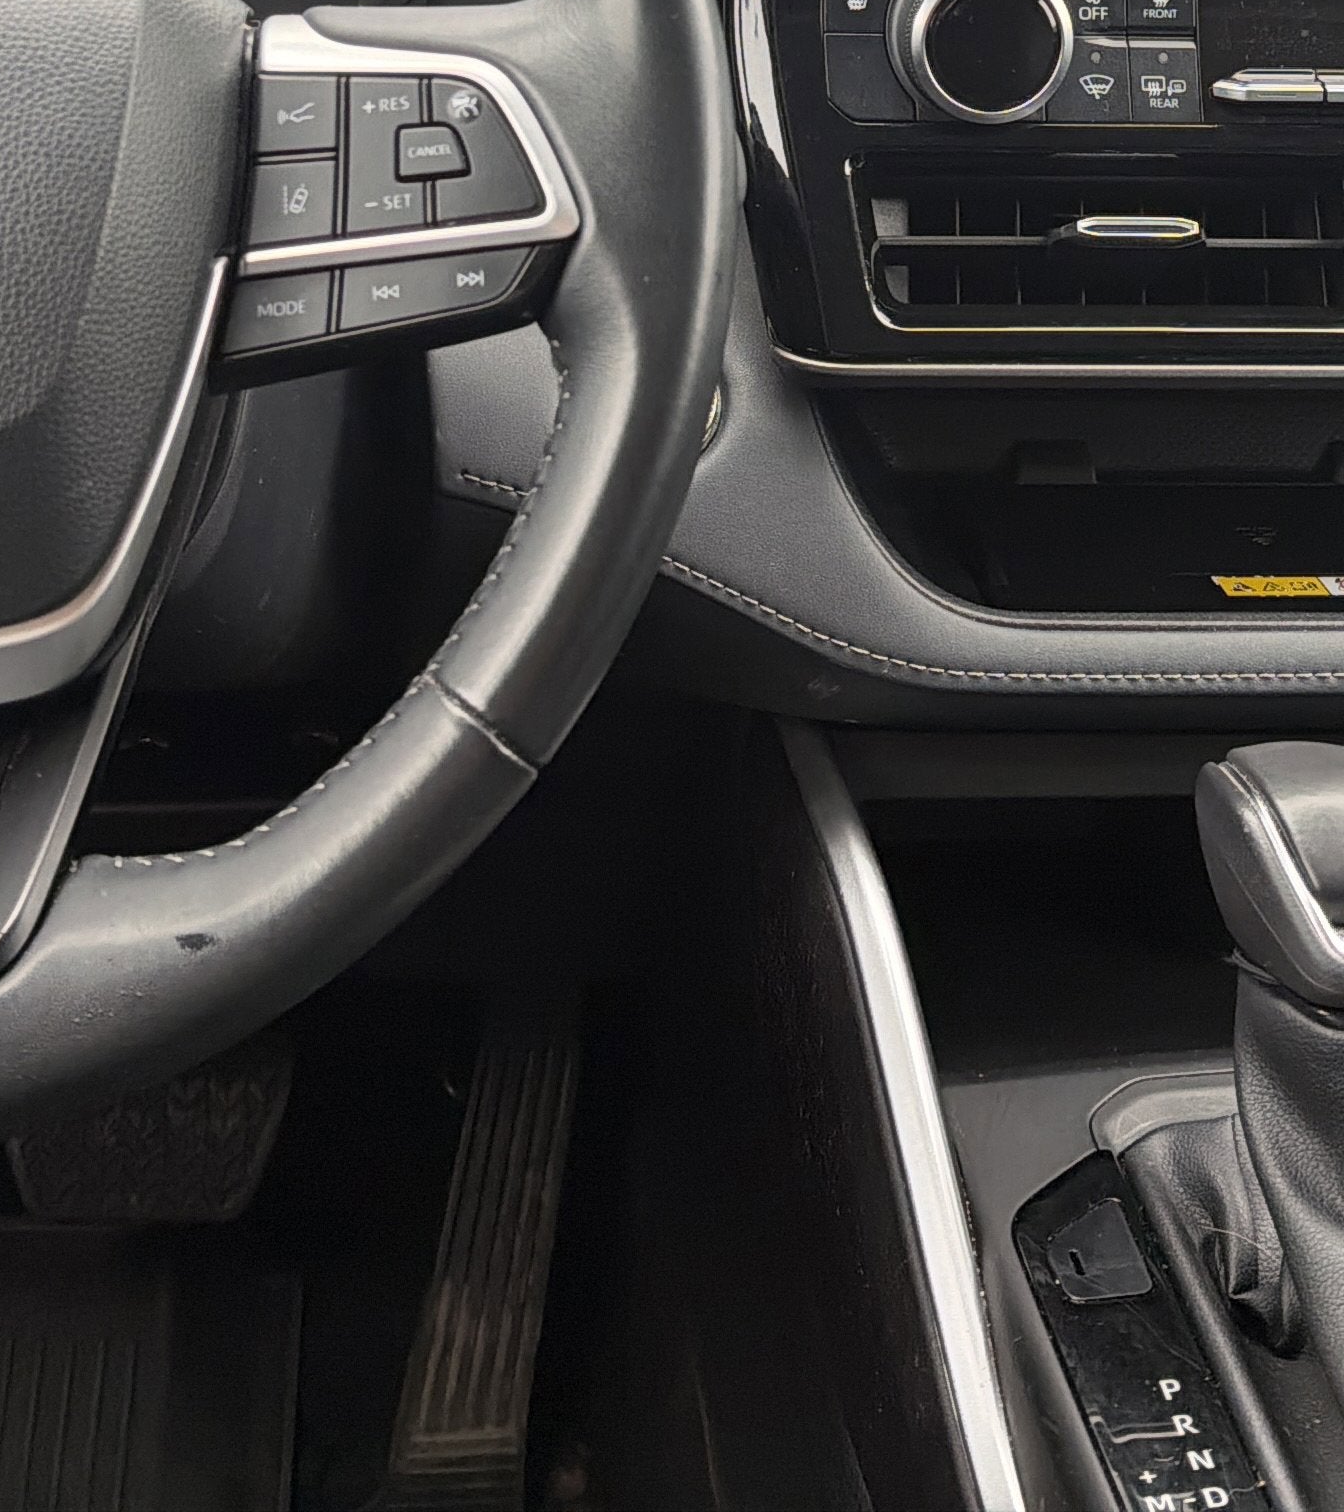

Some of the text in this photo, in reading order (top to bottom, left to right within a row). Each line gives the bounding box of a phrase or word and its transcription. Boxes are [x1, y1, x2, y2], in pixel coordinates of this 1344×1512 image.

[1078, 6, 1109, 21] OFF
[1142, 8, 1178, 19] FRONT
[1149, 98, 1180, 109] REAR
[407, 143, 453, 159] CANCEL
[256, 298, 307, 318] MODE
[1158, 1378, 1181, 1401] P
[1171, 1414, 1200, 1436] R
[1186, 1448, 1216, 1471] N
[1143, 1486, 1229, 1512] M D
